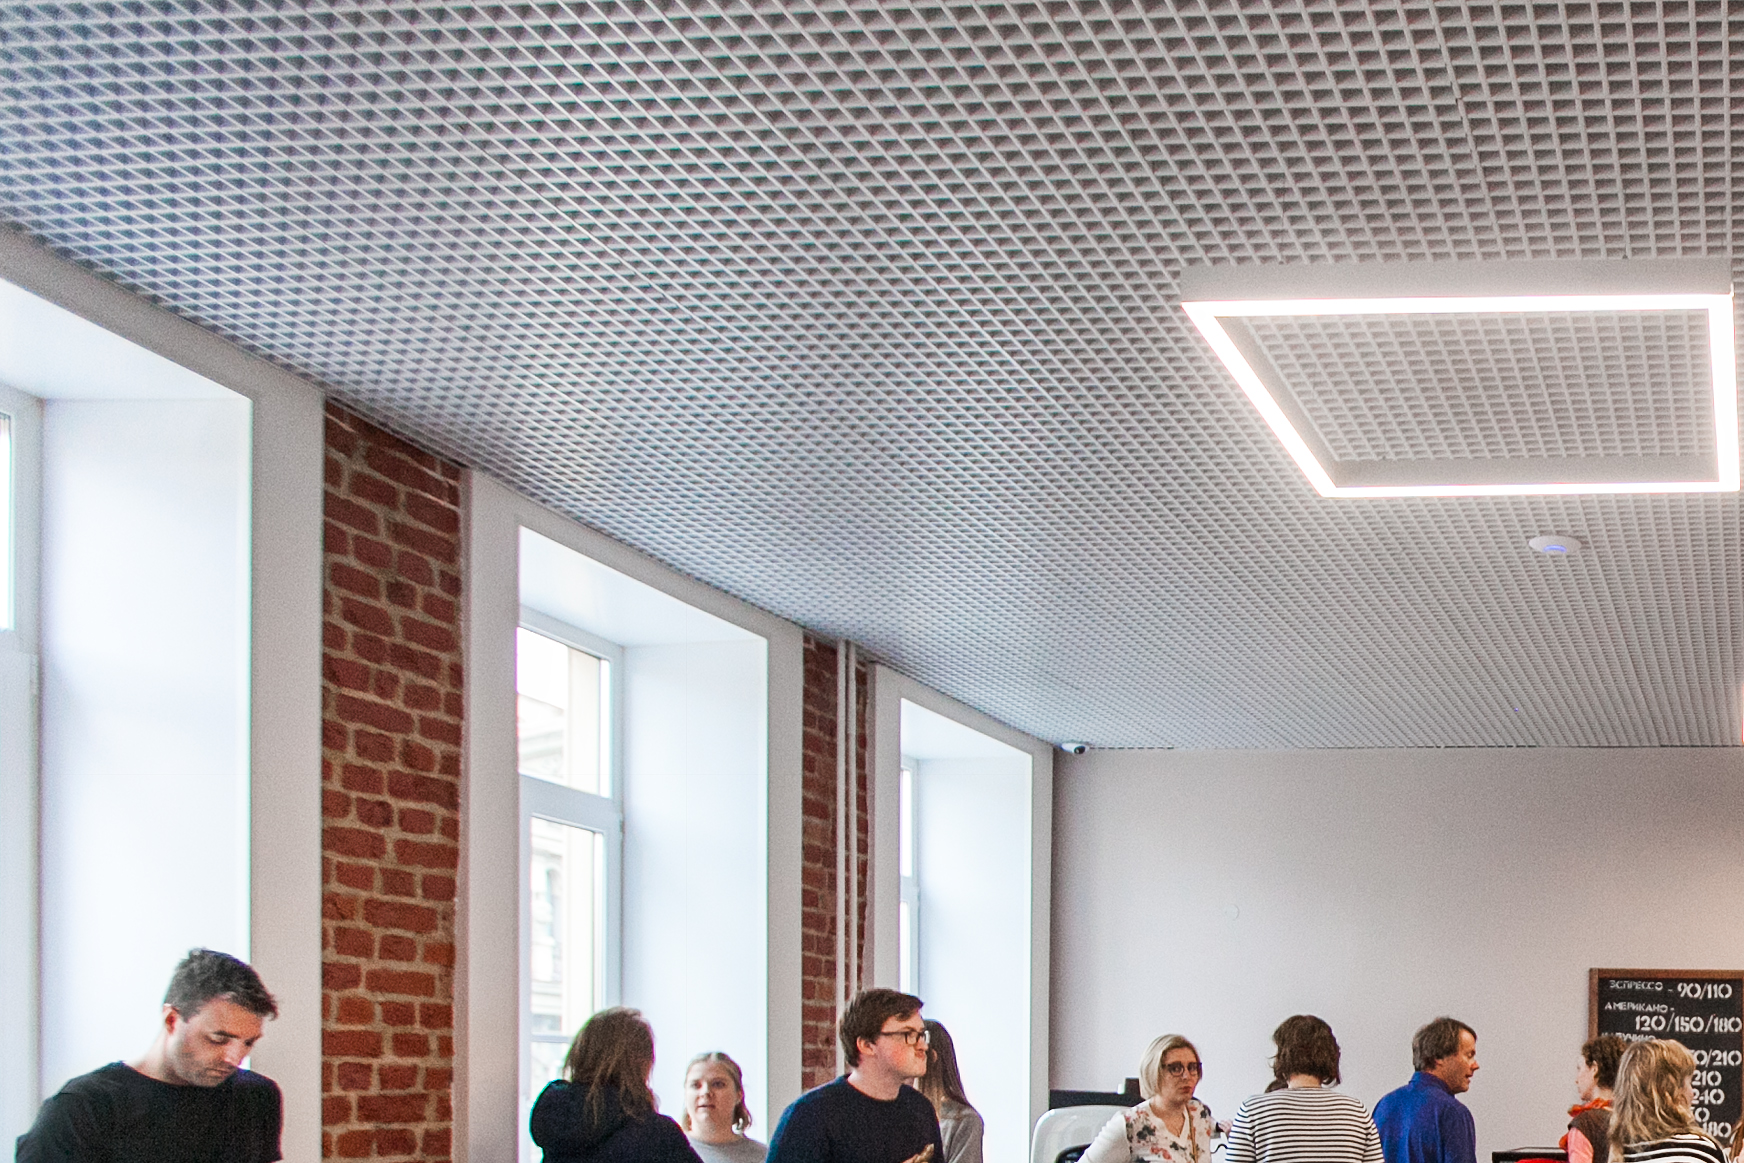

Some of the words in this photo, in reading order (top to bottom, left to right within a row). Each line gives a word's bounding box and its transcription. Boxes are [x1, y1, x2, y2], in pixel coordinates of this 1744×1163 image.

[1677, 982, 1733, 1000] 90/110
[1604, 1001, 1669, 1013] АМЕРИКАНО
[1690, 1048, 1743, 1068] 0/210
